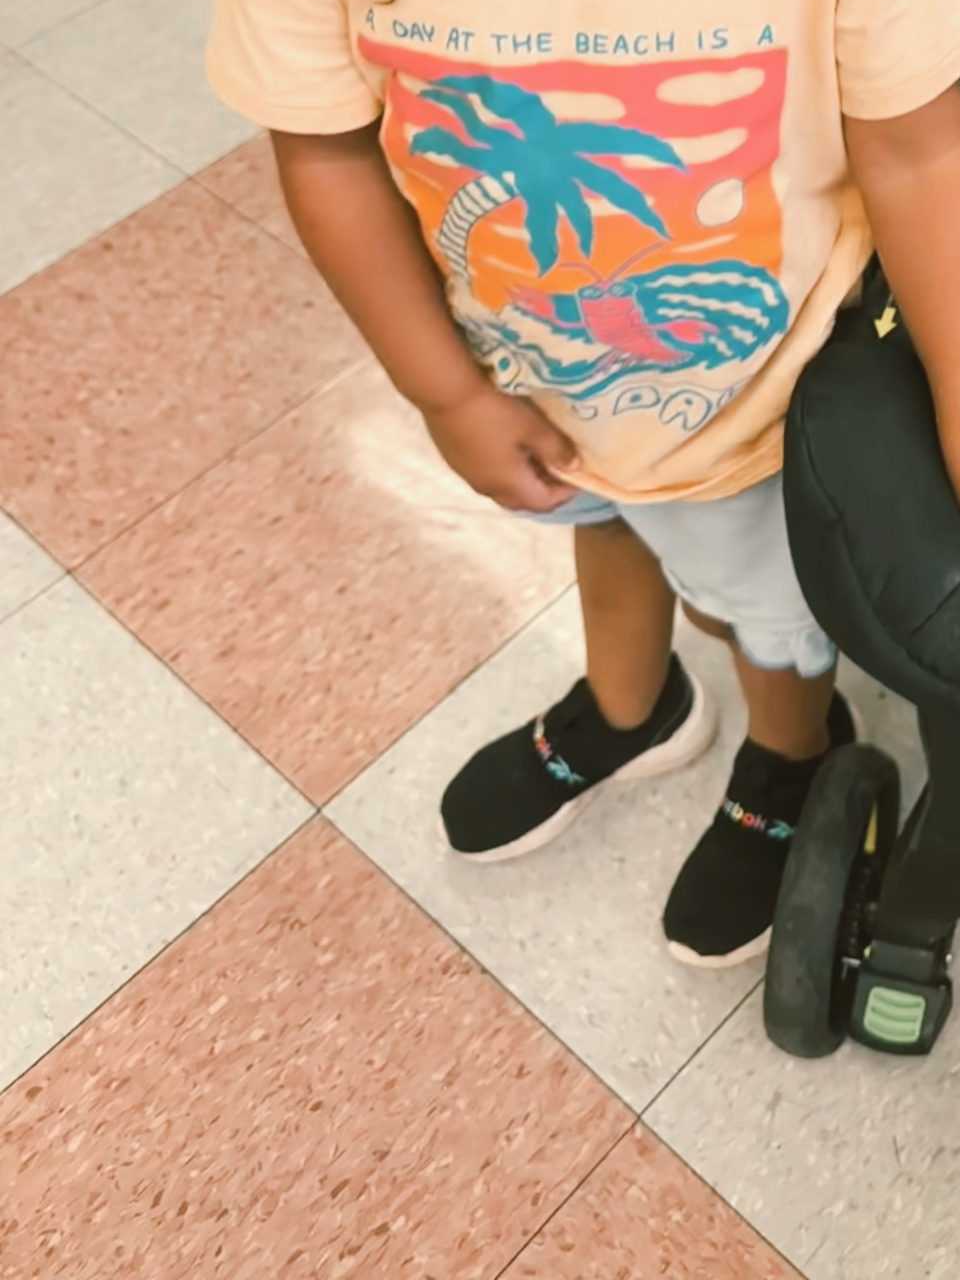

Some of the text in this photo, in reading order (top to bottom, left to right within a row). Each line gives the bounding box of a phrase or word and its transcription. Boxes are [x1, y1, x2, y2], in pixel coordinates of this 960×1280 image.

[365, 7, 774, 55] A DAY AT THE BEACH IS A
